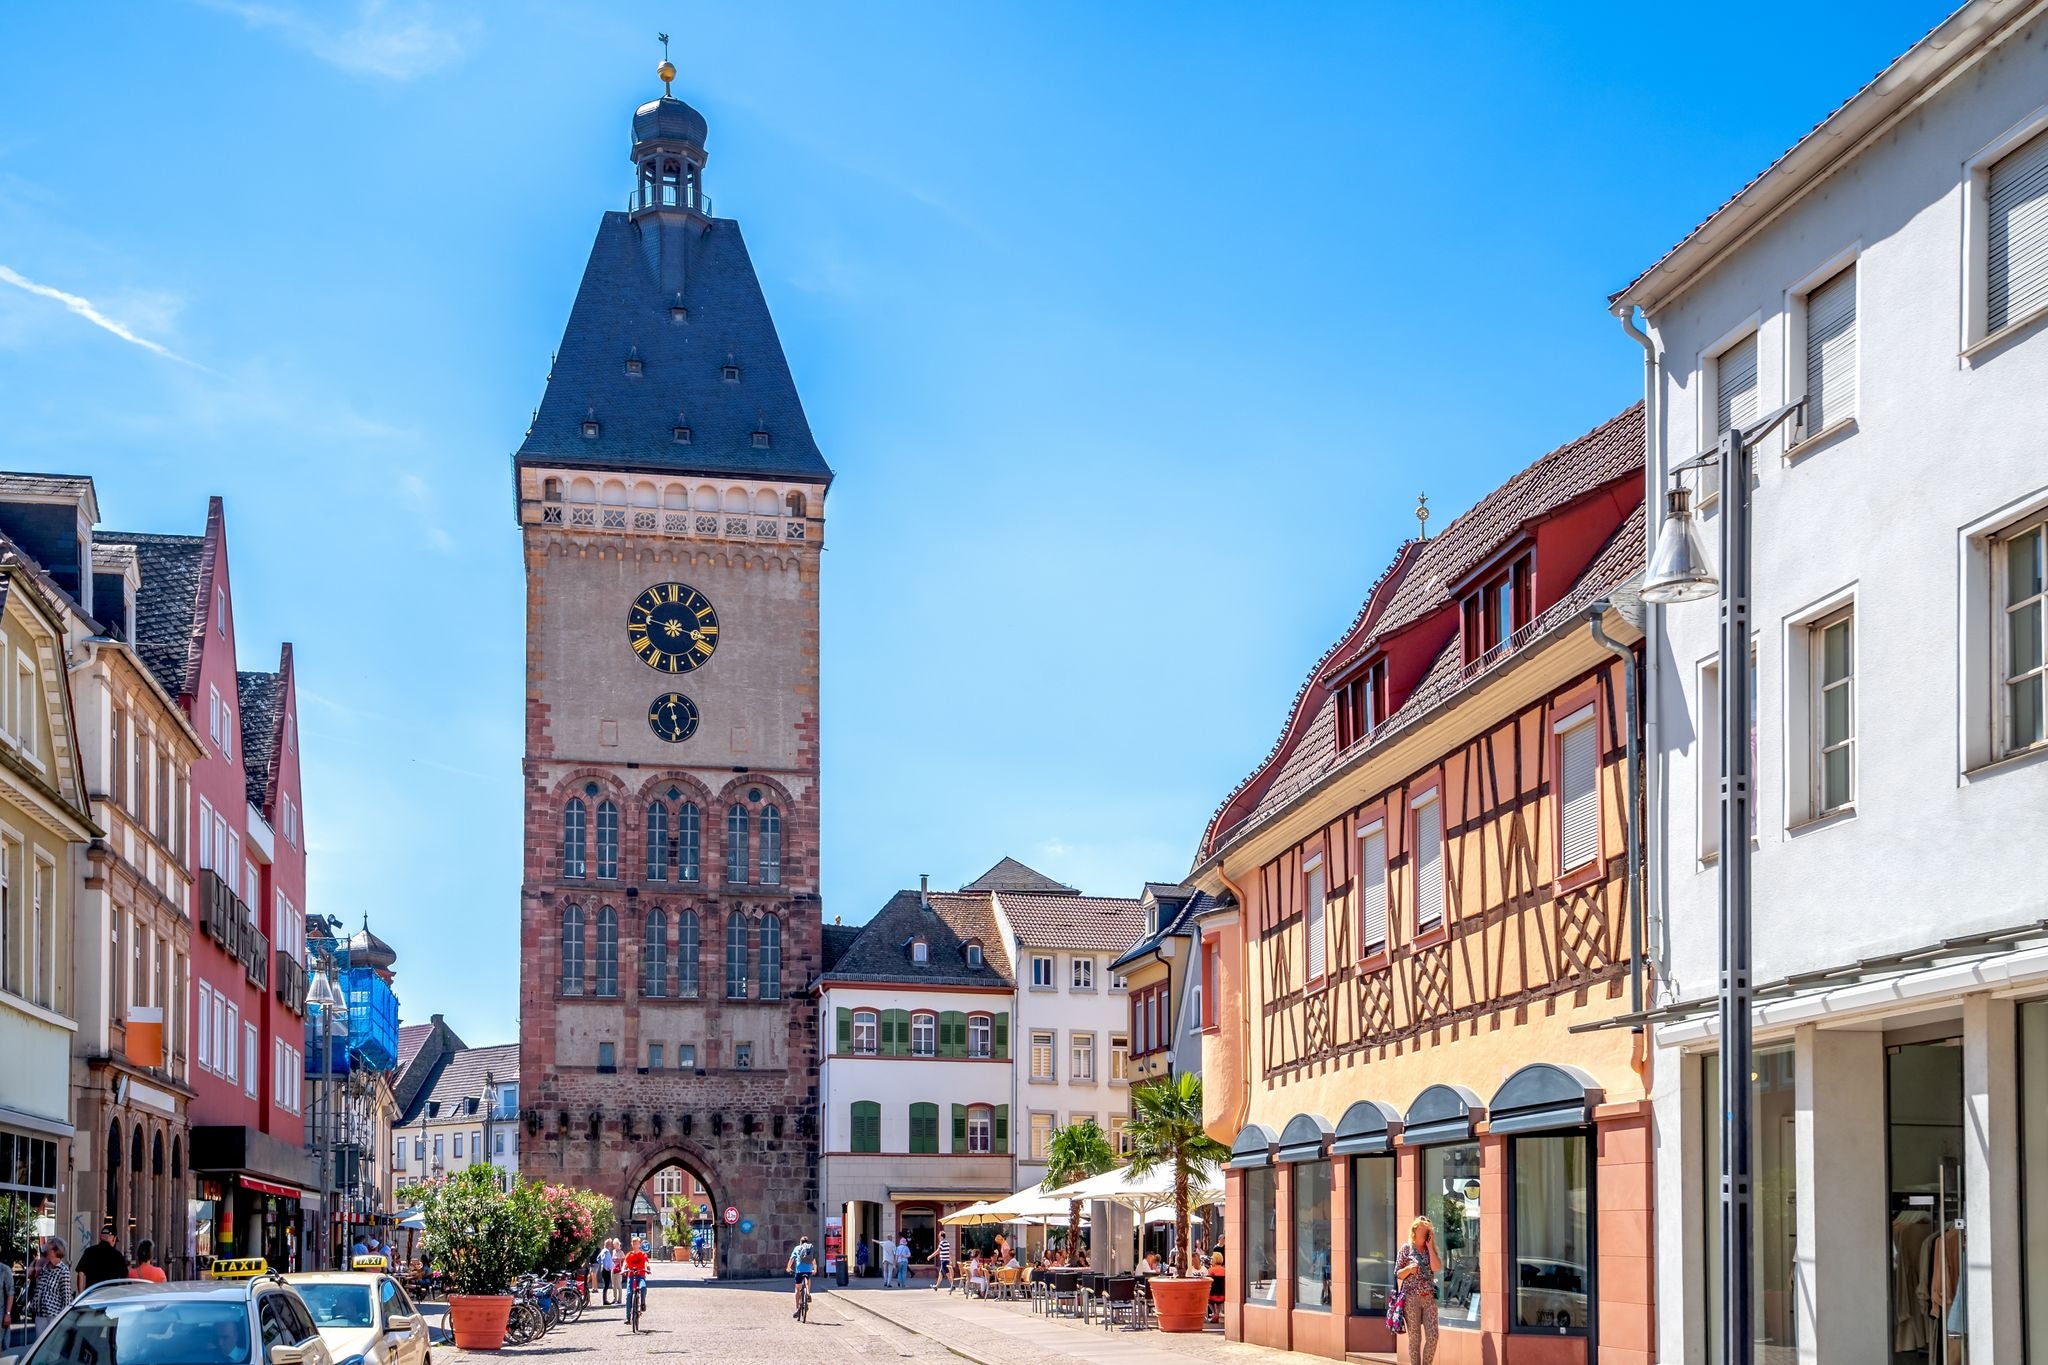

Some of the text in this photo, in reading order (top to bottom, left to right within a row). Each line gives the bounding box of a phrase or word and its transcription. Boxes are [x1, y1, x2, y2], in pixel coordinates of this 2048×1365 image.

[648, 588, 662, 605] XI
[667, 584, 679, 602] XII
[685, 591, 696, 606] I
[695, 606, 713, 619] II
[628, 623, 646, 631] IX
[700, 626, 718, 634] III
[632, 636, 651, 654] VIII
[694, 639, 715, 656] IIII
[647, 649, 662, 668] VII
[670, 655, 678, 672] VI
[687, 652, 698, 668] V
[220, 1260, 256, 1272] TAXI
[358, 1256, 381, 1265] TAXI
